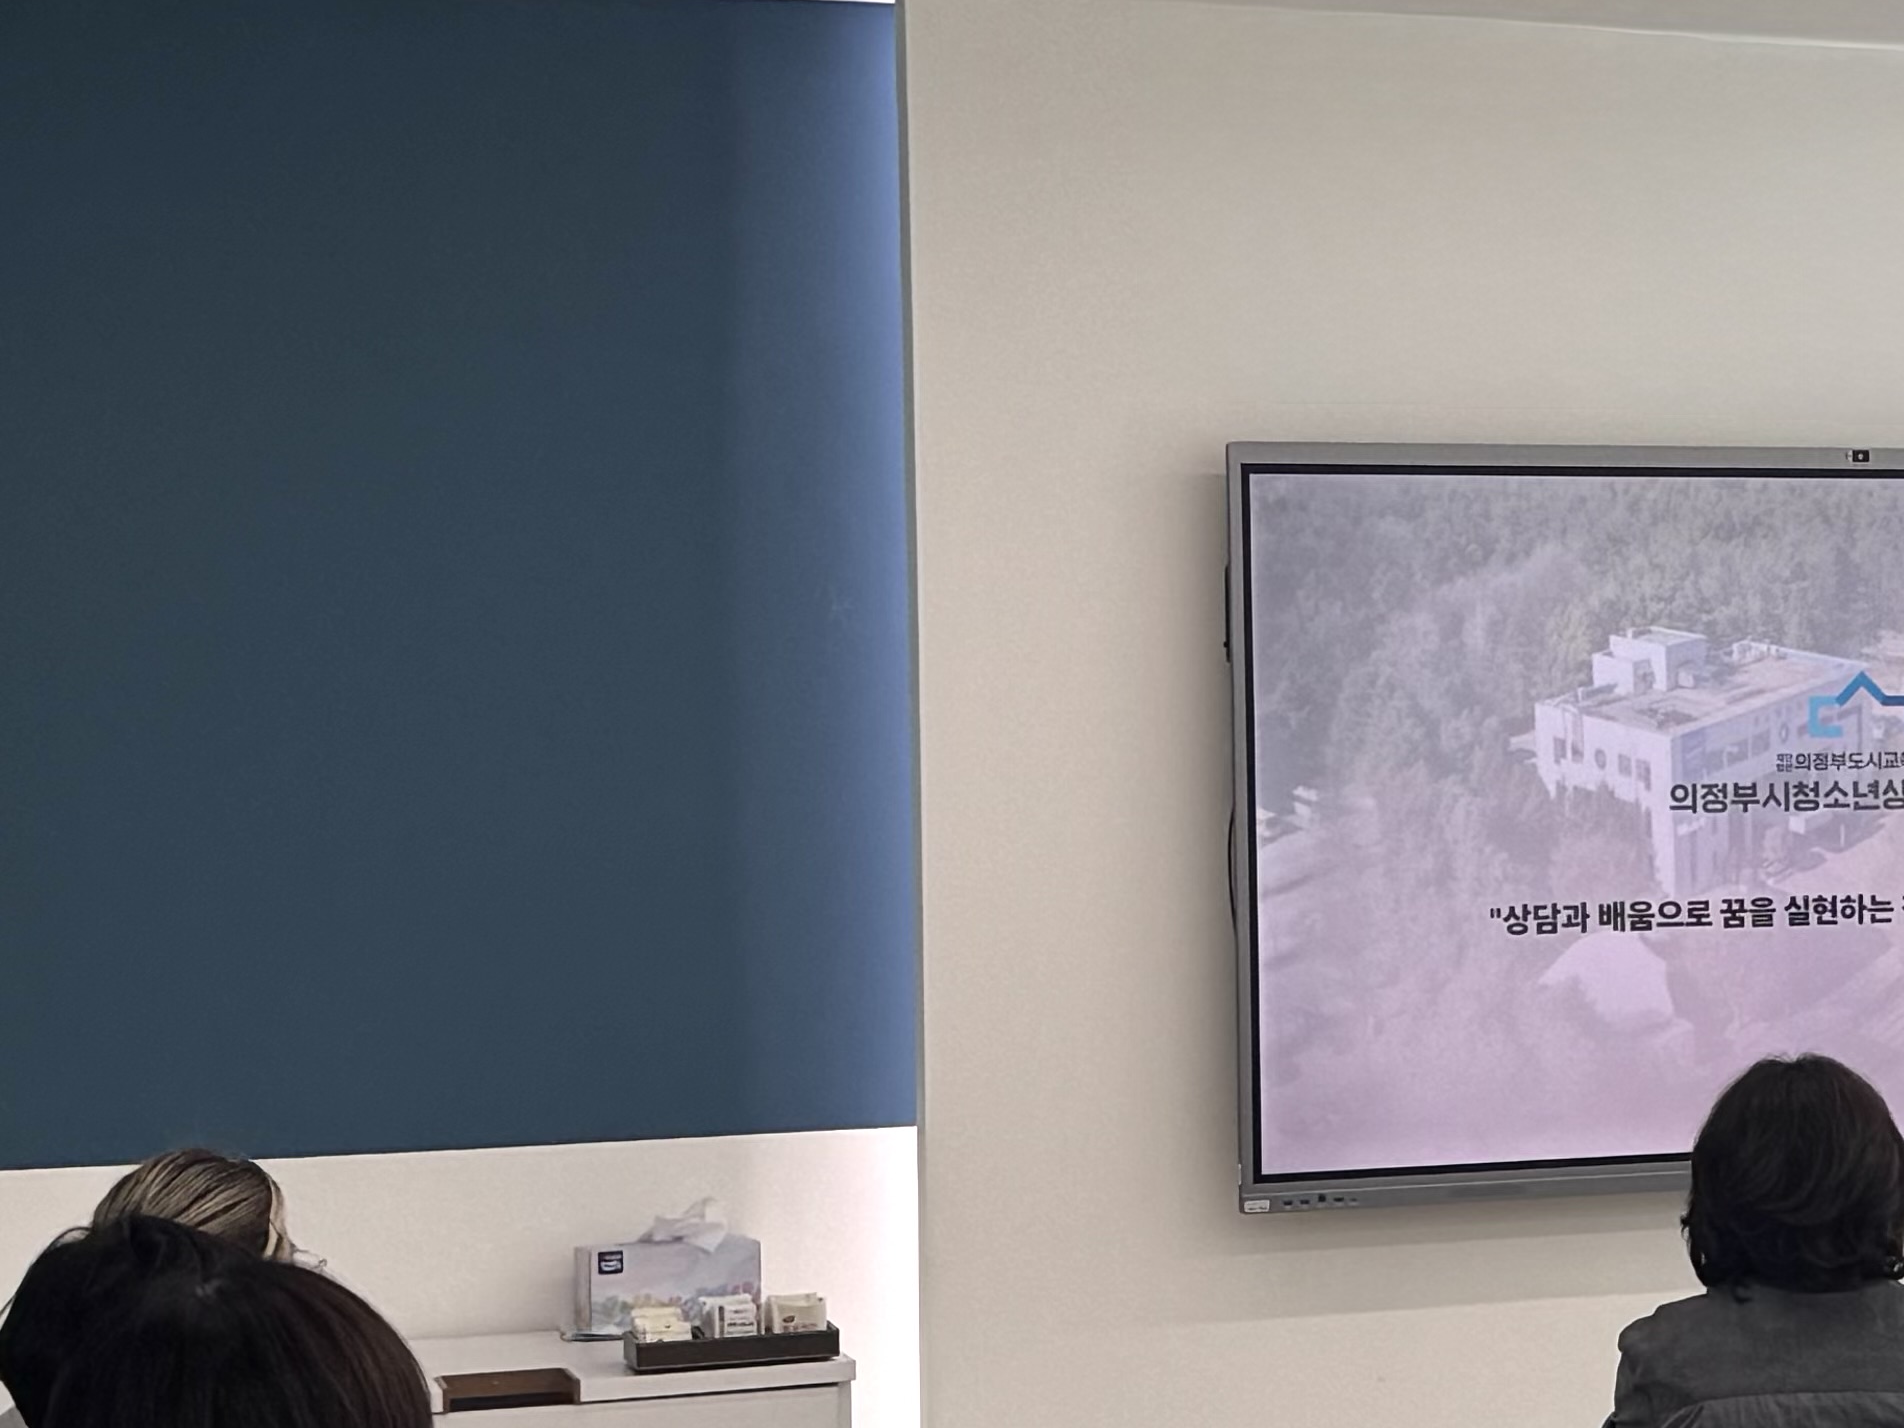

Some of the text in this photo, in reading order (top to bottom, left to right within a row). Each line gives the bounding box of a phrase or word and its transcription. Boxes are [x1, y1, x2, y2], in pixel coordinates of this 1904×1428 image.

[1489, 902, 1590, 936] "상담과
[1598, 900, 1713, 932] 배움으로
[1720, 896, 1776, 929] 꿈을
[1784, 893, 1894, 926] 실현하는
